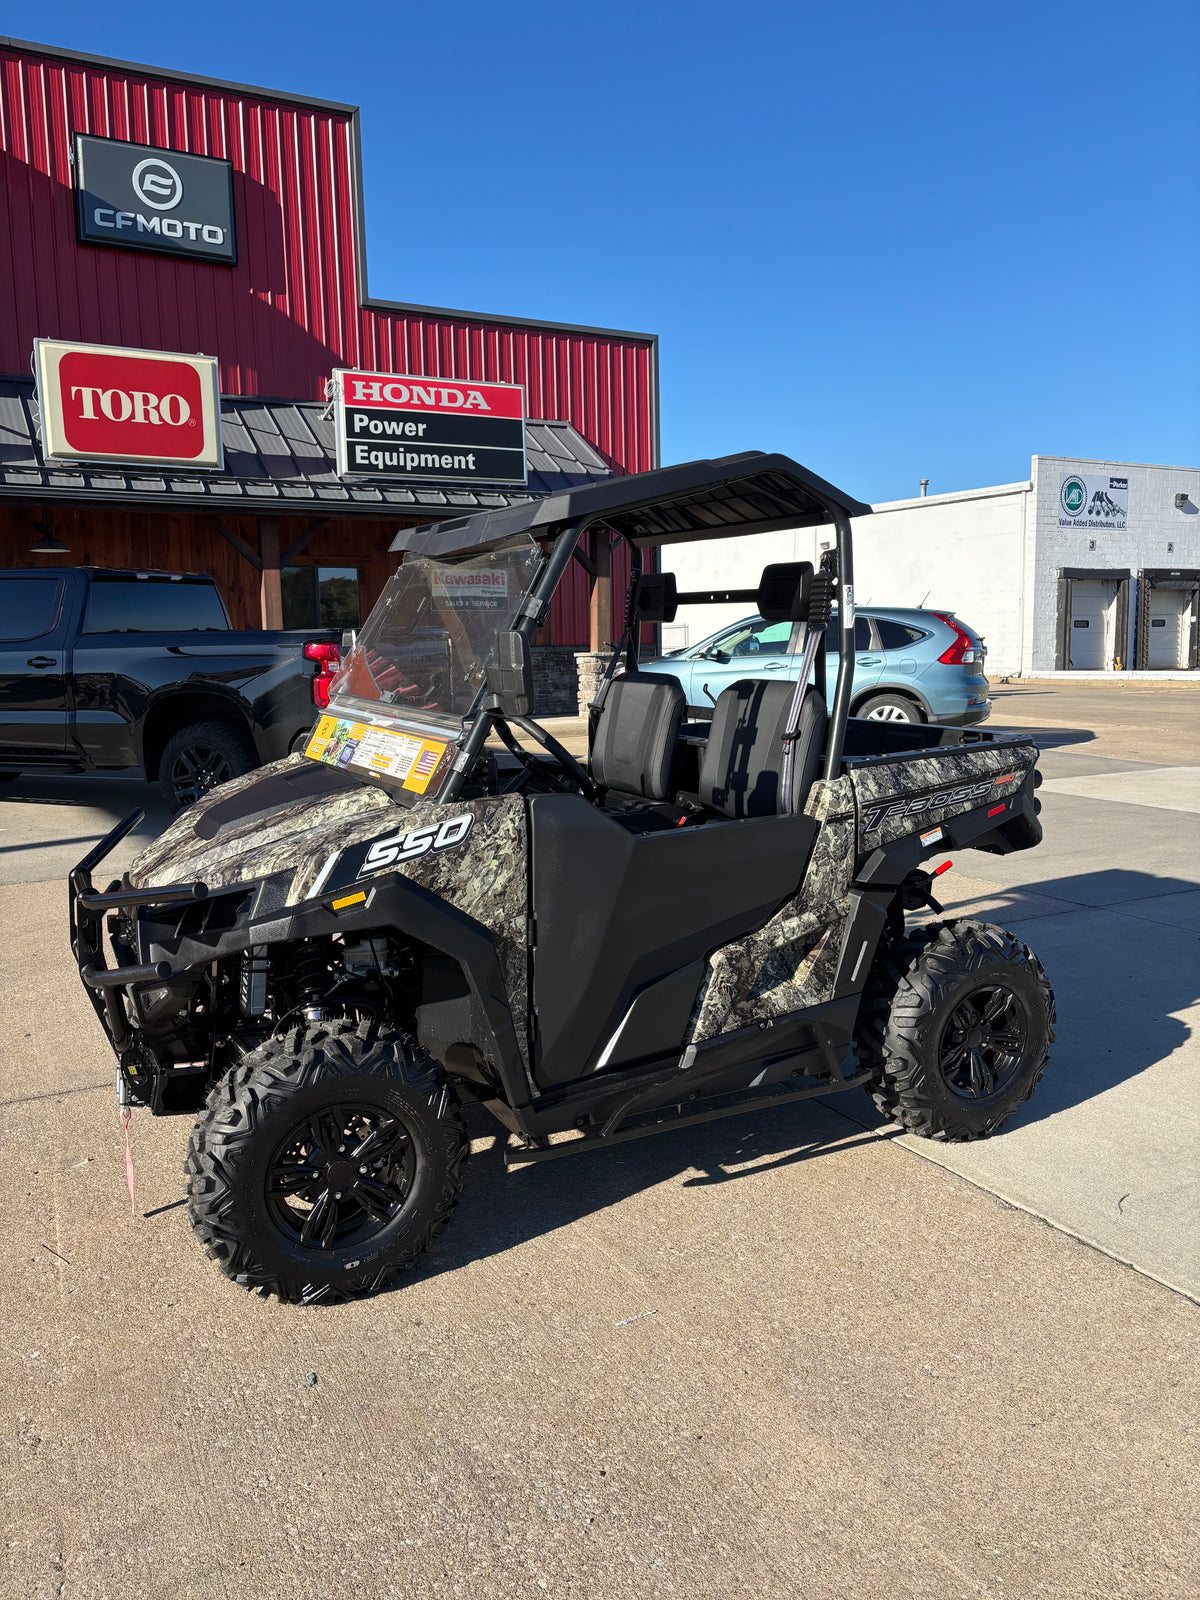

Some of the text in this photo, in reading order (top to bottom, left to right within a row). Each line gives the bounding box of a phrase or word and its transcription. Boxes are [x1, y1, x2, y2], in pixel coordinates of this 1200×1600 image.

[94, 208, 225, 245] CFMOTO
[71, 386, 191, 426] TORO
[352, 381, 491, 410] HONDA
[353, 413, 427, 437] Power
[355, 444, 476, 471] Equipment
[1059, 518, 1072, 526] Value
[1073, 519, 1088, 527] Added
[433, 572, 505, 585] Kawasaki
[864, 779, 995, 833] T-BOSS
[361, 812, 473, 873] 550
